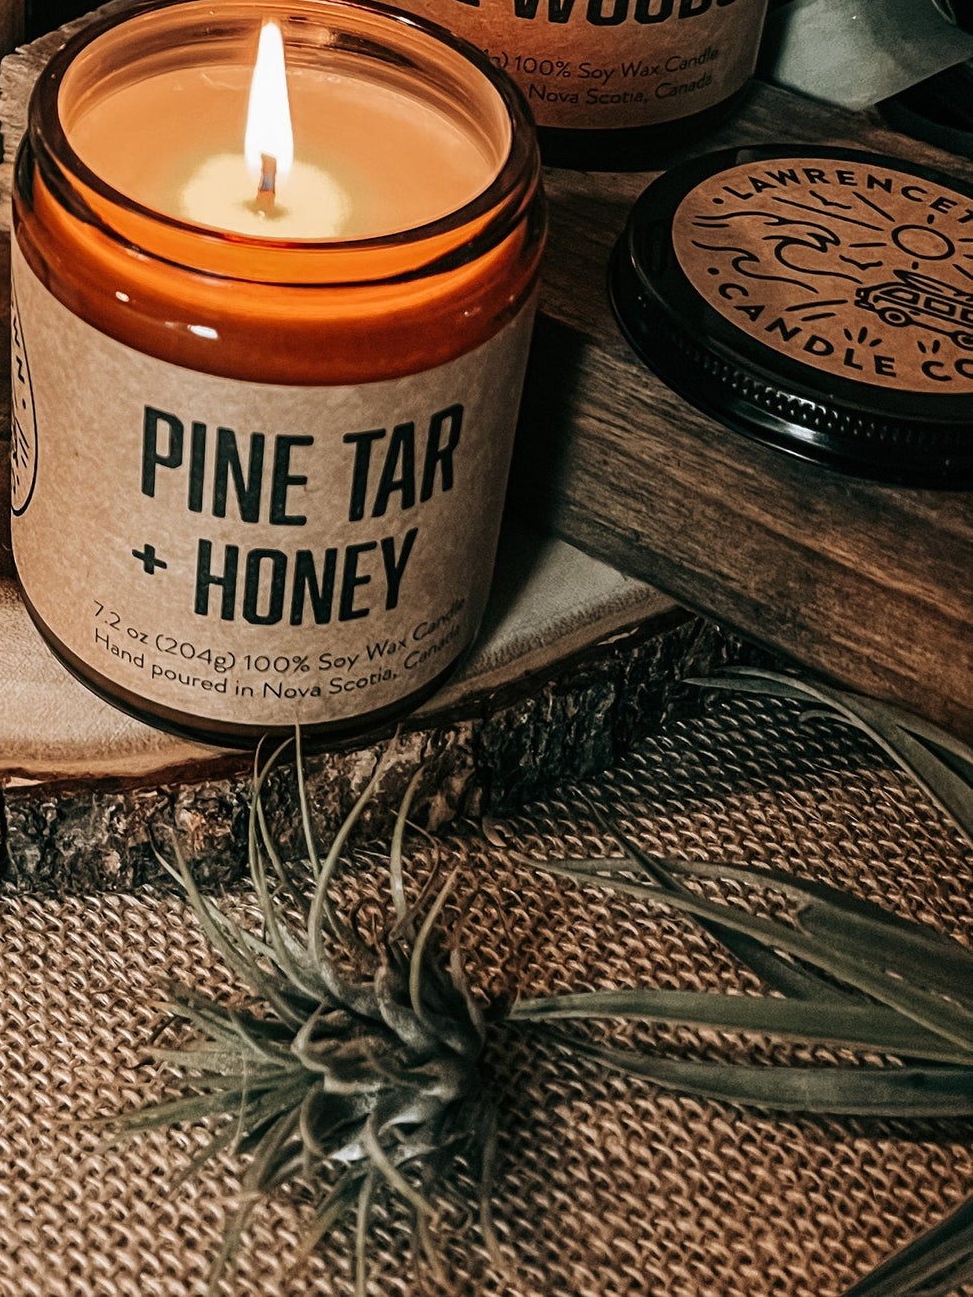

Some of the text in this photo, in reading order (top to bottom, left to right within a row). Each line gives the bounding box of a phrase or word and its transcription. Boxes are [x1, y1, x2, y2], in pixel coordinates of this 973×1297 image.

[515, 54, 571, 78] 100%
[577, 62, 615, 85] Soy
[621, 61, 659, 78] Wax
[664, 45, 720, 74] Candle
[528, 83, 580, 104] Nova
[654, 72, 713, 100] Canada
[718, 282, 897, 378] CANDLE
[141, 403, 465, 526] PINE TAR
[194, 527, 419, 626] HONEY
[93, 598, 465, 674] 7.2 oz (204g) 100% Soy Wax Candle
[94, 624, 461, 699] Hand poured in Nova Scotia, Canada
